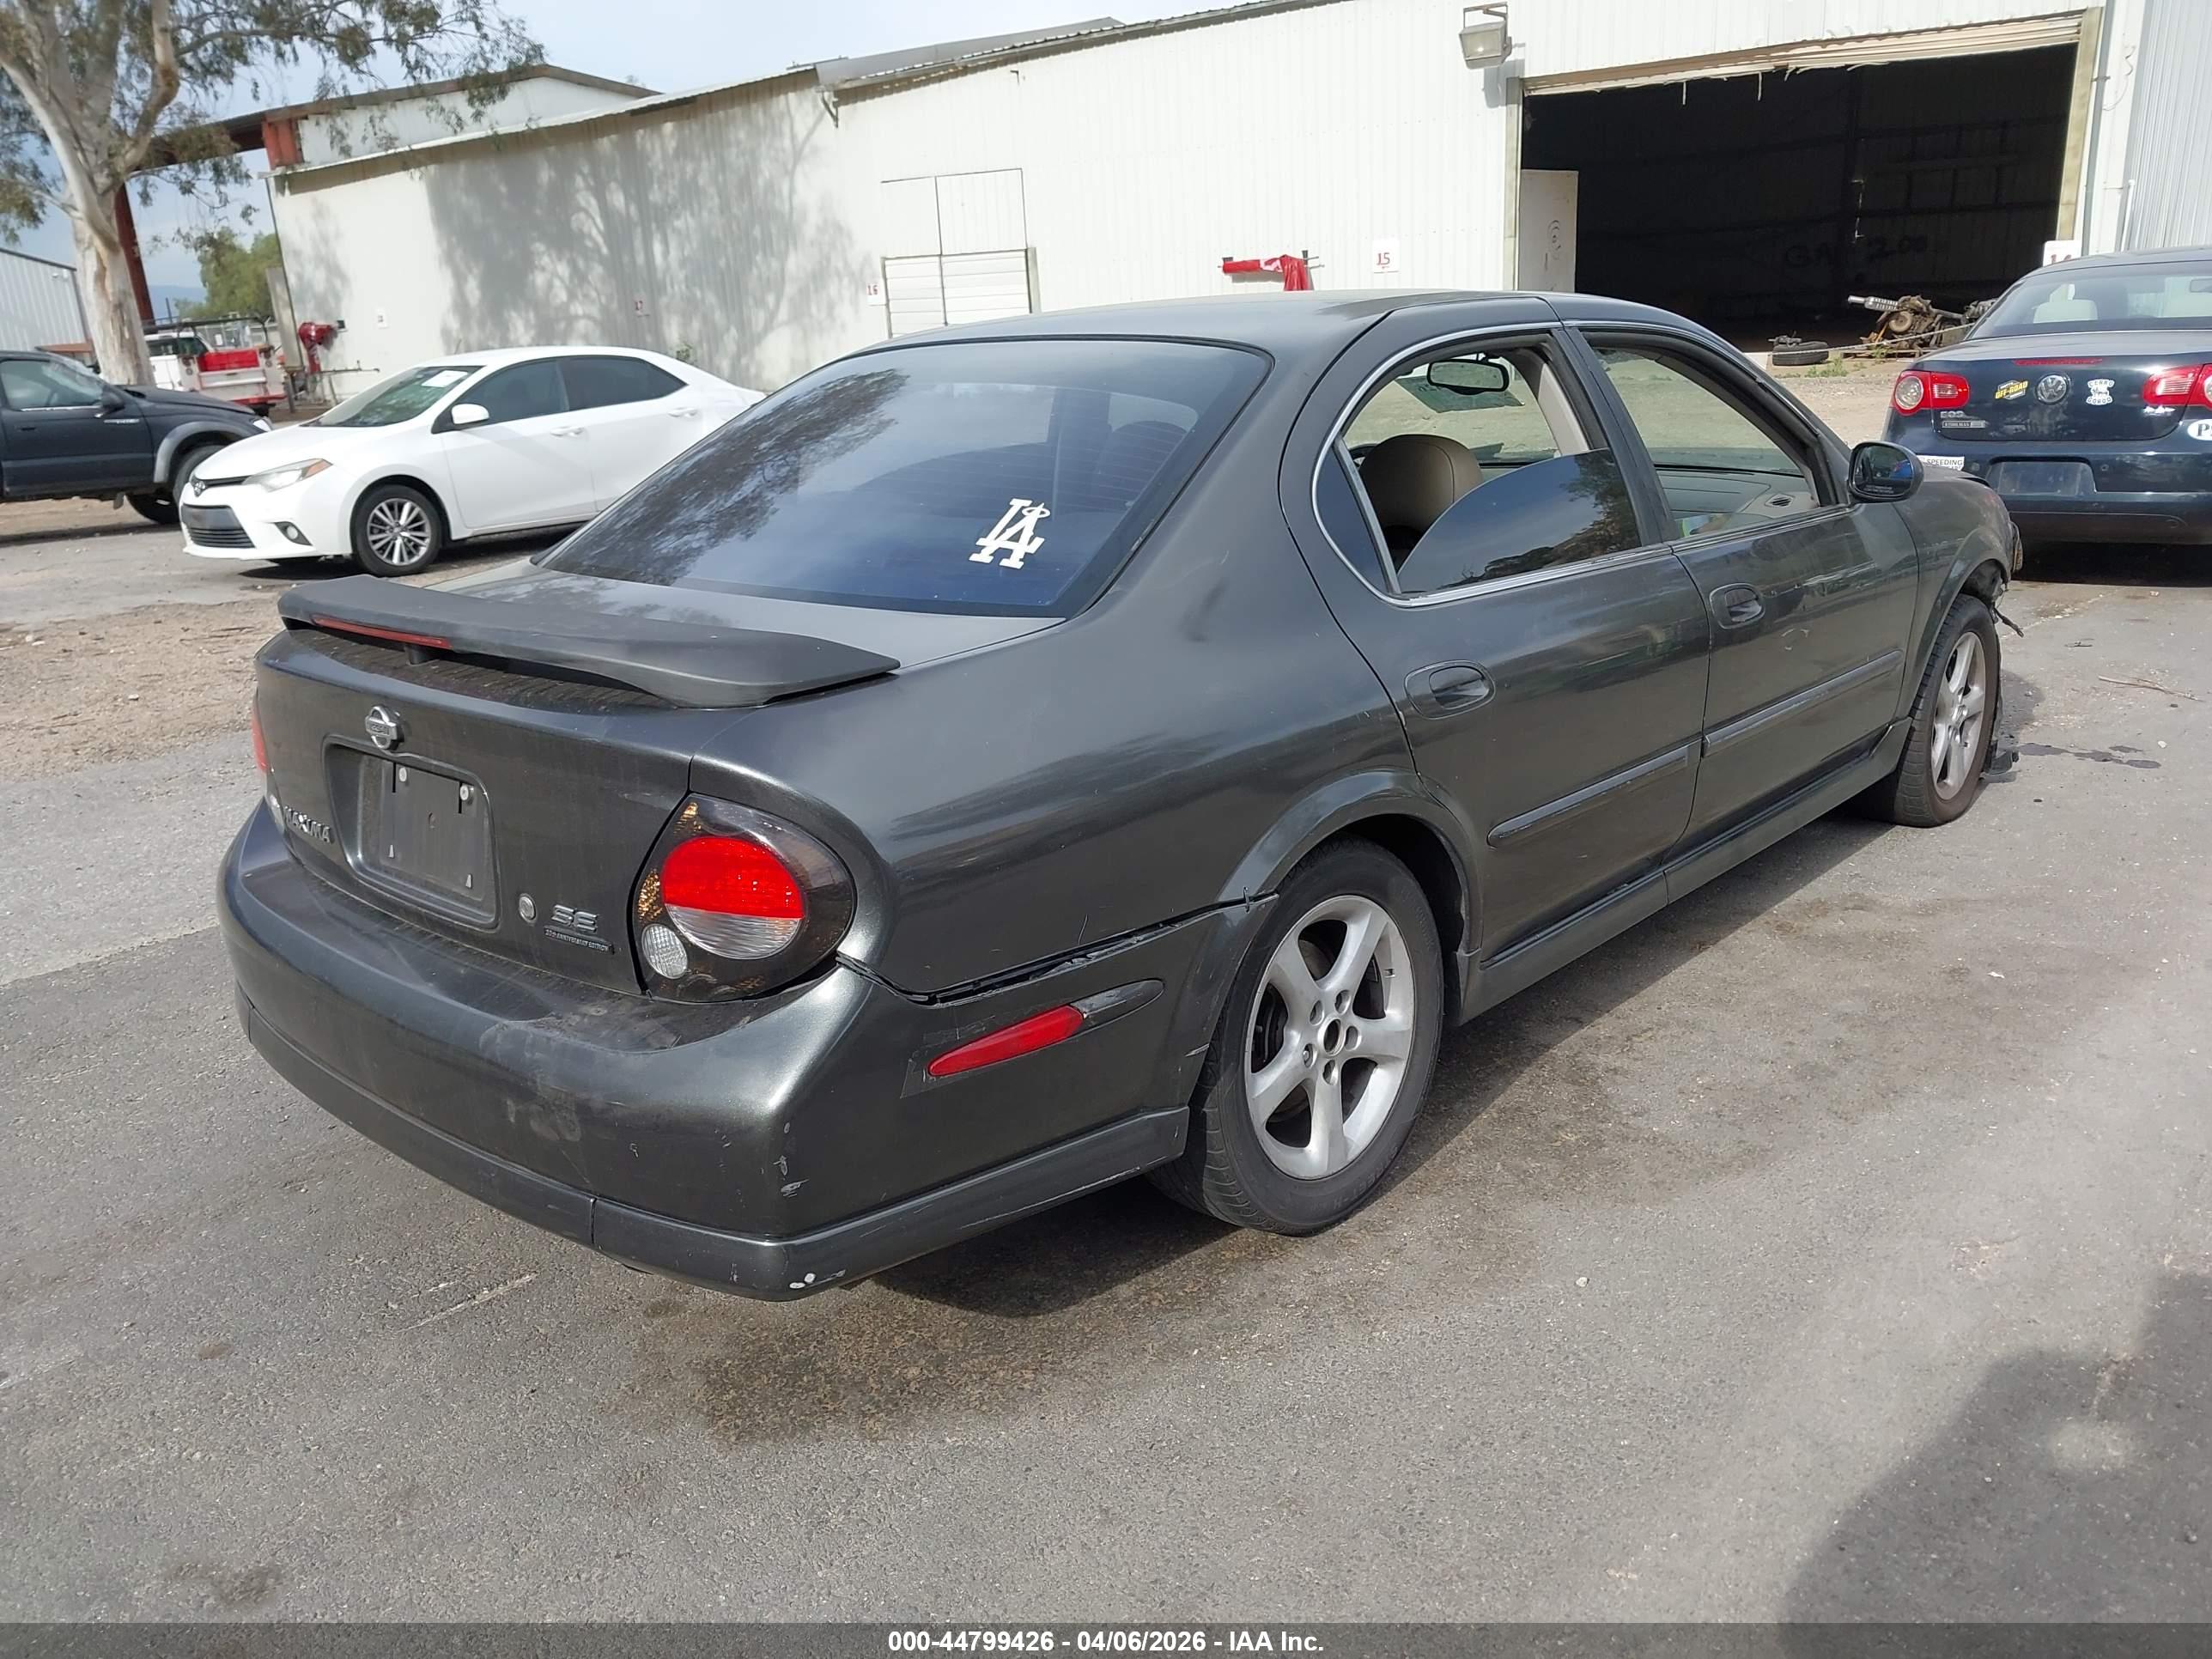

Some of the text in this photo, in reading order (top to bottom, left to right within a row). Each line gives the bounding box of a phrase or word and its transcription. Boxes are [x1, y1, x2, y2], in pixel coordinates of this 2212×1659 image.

[1376, 252, 1390, 265] 15
[1995, 380, 2028, 398] OFF-ROAD
[969, 498, 1051, 569] LA
[551, 904, 598, 932] SE
